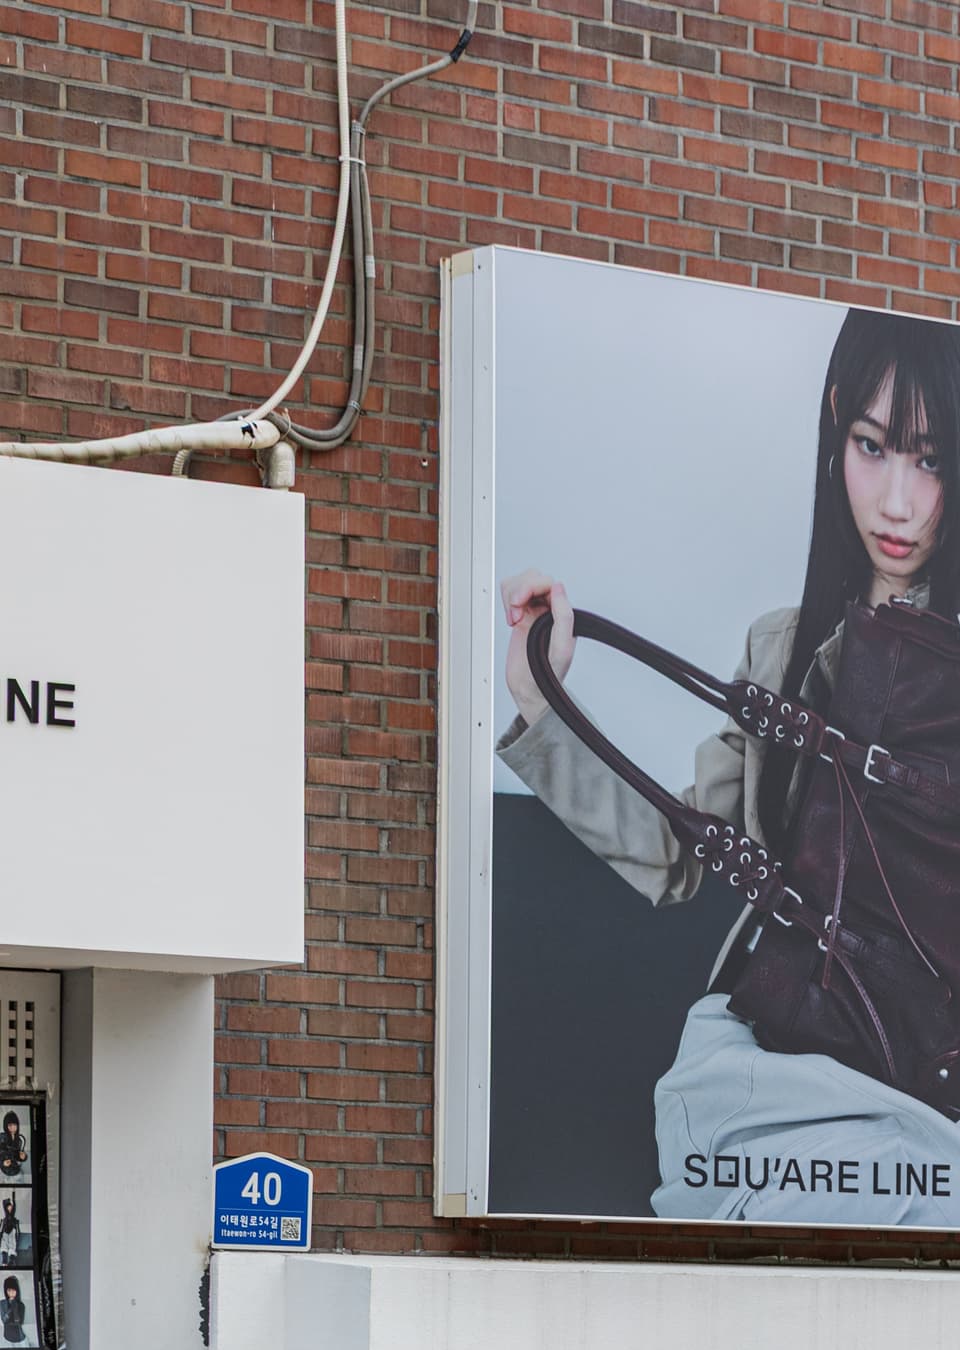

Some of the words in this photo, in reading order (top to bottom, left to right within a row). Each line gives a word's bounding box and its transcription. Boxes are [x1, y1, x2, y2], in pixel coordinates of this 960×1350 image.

[241, 1171, 282, 1206] 40
[872, 1161, 951, 1197] LINE
[220, 1215, 278, 1230] 이태원로54길
[221, 1229, 257, 1238] Itaewon-ro
[258, 1231, 278, 1240] 54-gil
